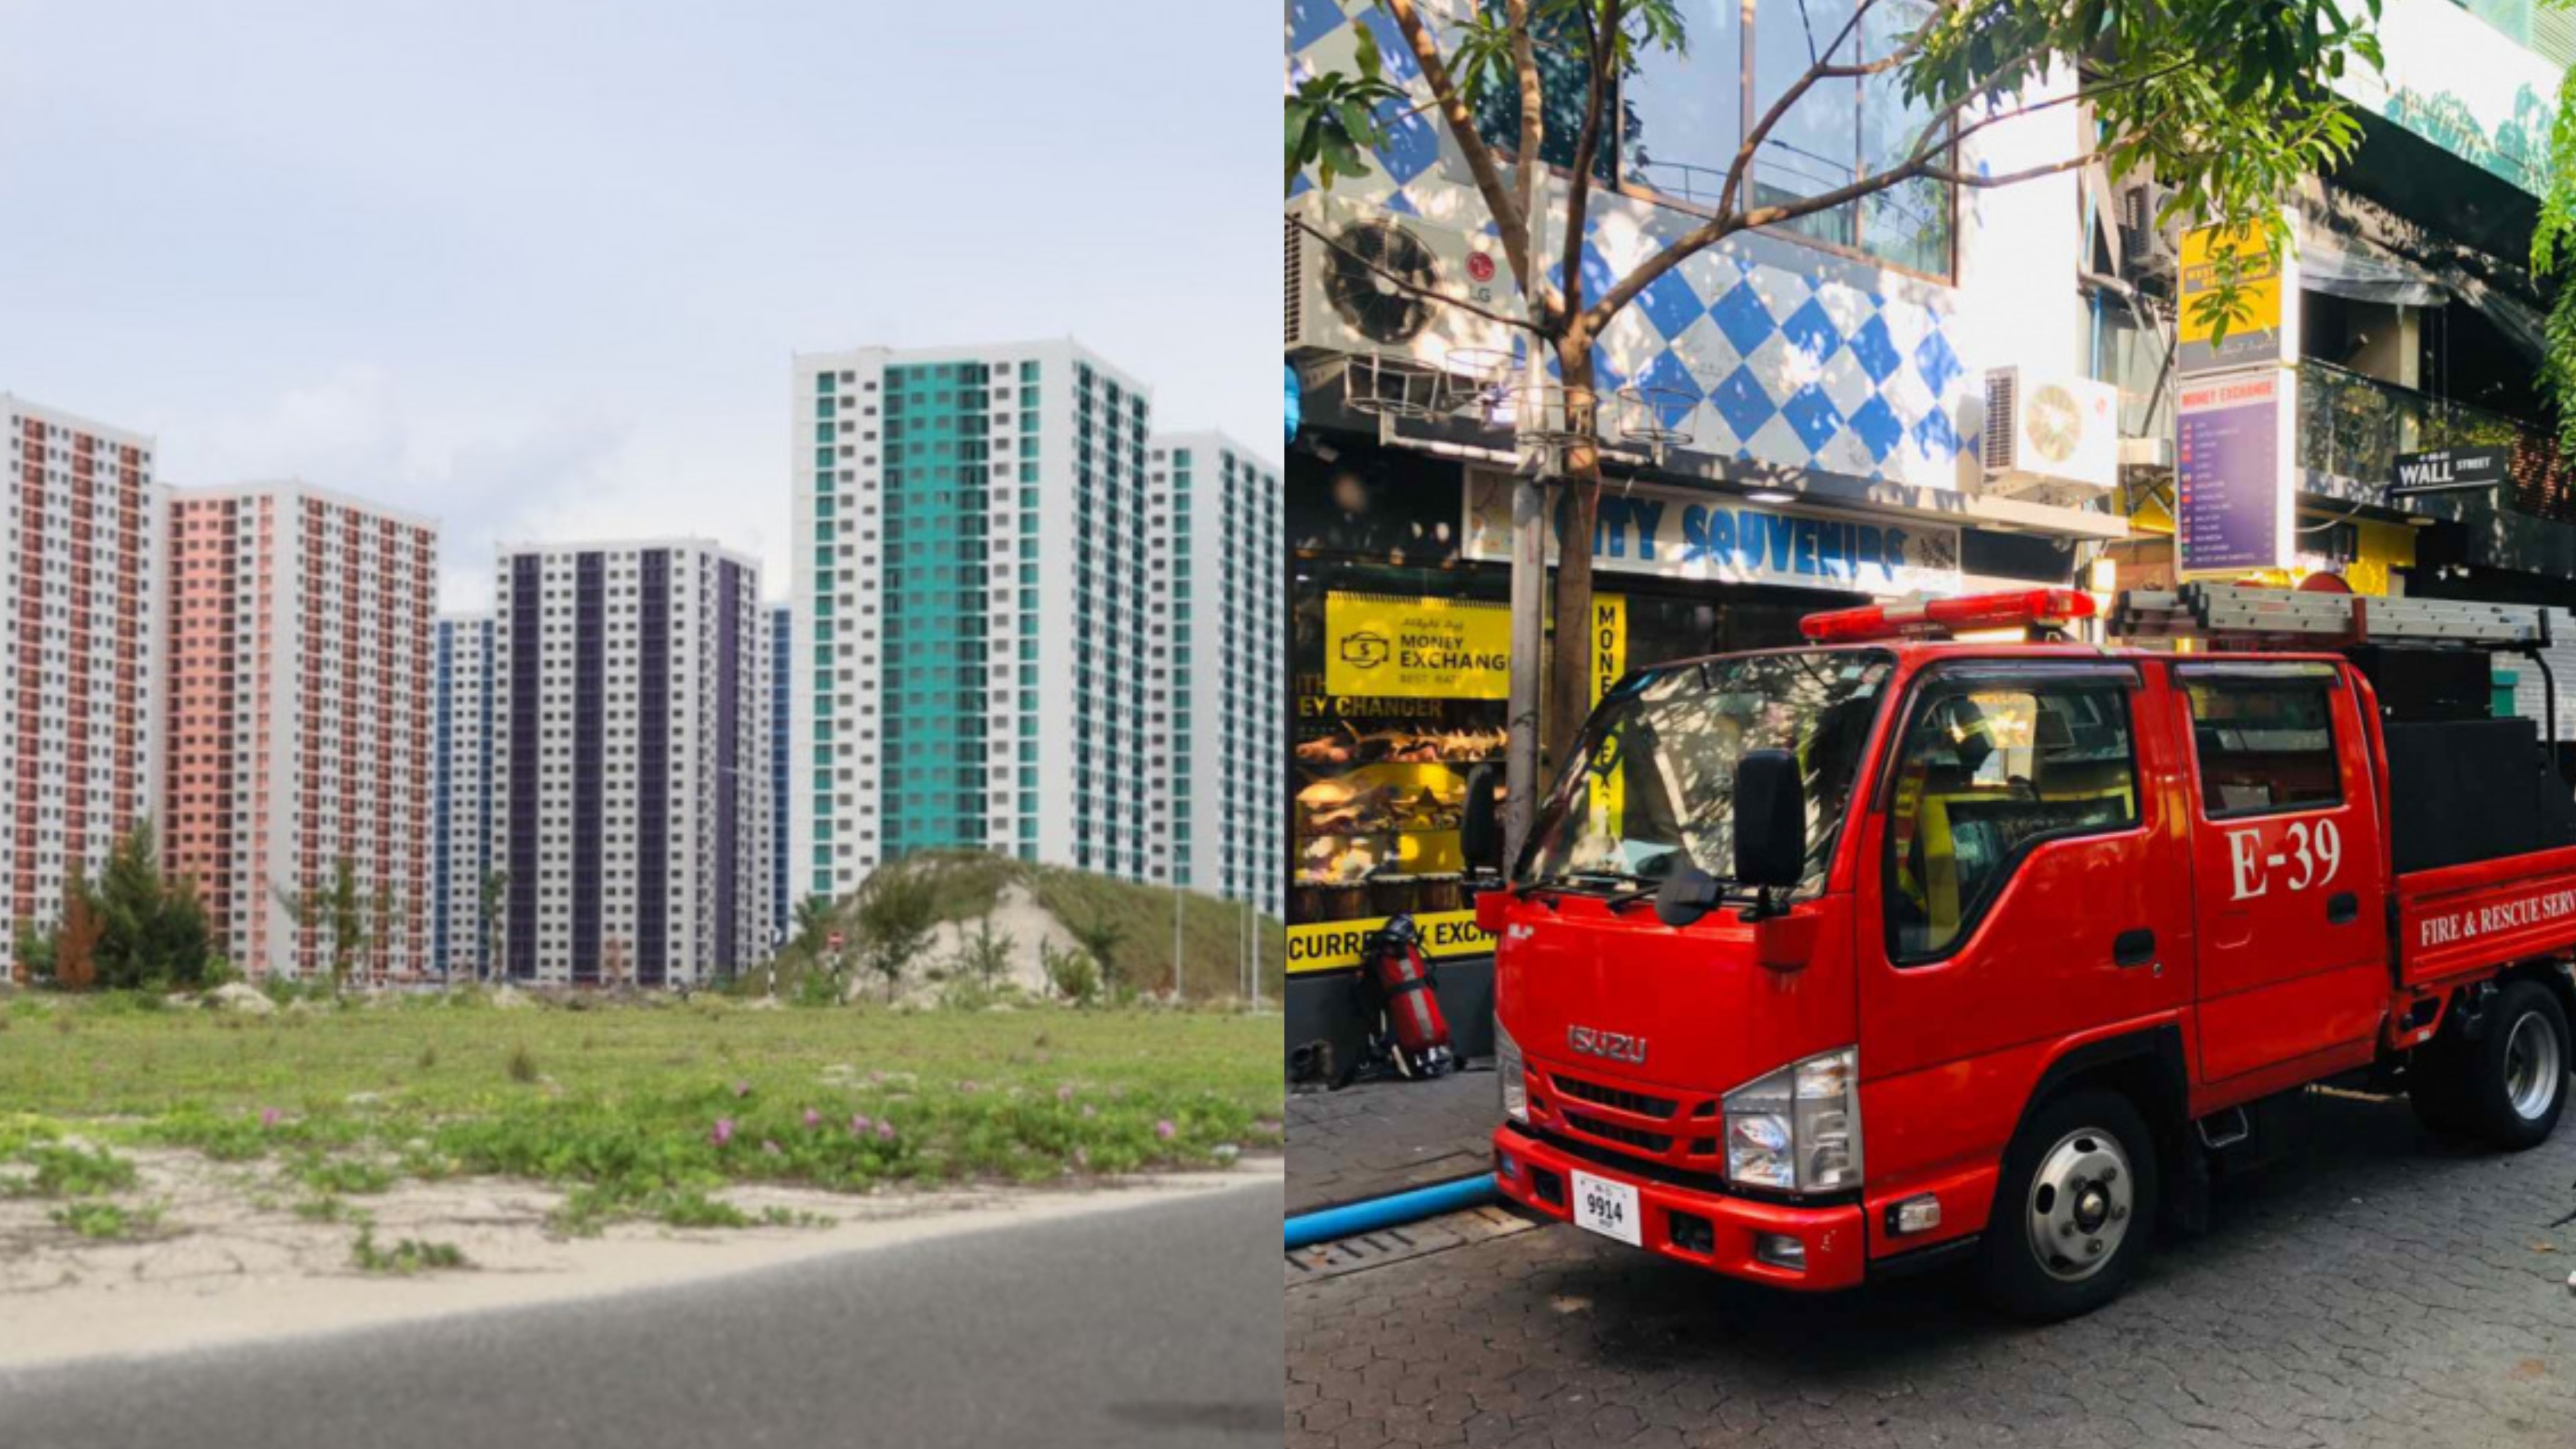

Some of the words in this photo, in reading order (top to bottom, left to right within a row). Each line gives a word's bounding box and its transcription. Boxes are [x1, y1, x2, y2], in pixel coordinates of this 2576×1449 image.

[1468, 284, 1491, 303] LG
[2399, 461, 2455, 487] WALL
[1400, 634, 1463, 650] MONEY
[1400, 650, 1511, 671] EXCHANG
[1335, 696, 1443, 718] CHANGER
[2224, 818, 2341, 901] E-39
[2421, 913, 2461, 947] FIRE
[2463, 910, 2477, 938] &
[2480, 897, 2541, 933] RESCUE
[1567, 1023, 1646, 1065] ISUZU
[1587, 1192, 1623, 1224] 9914
